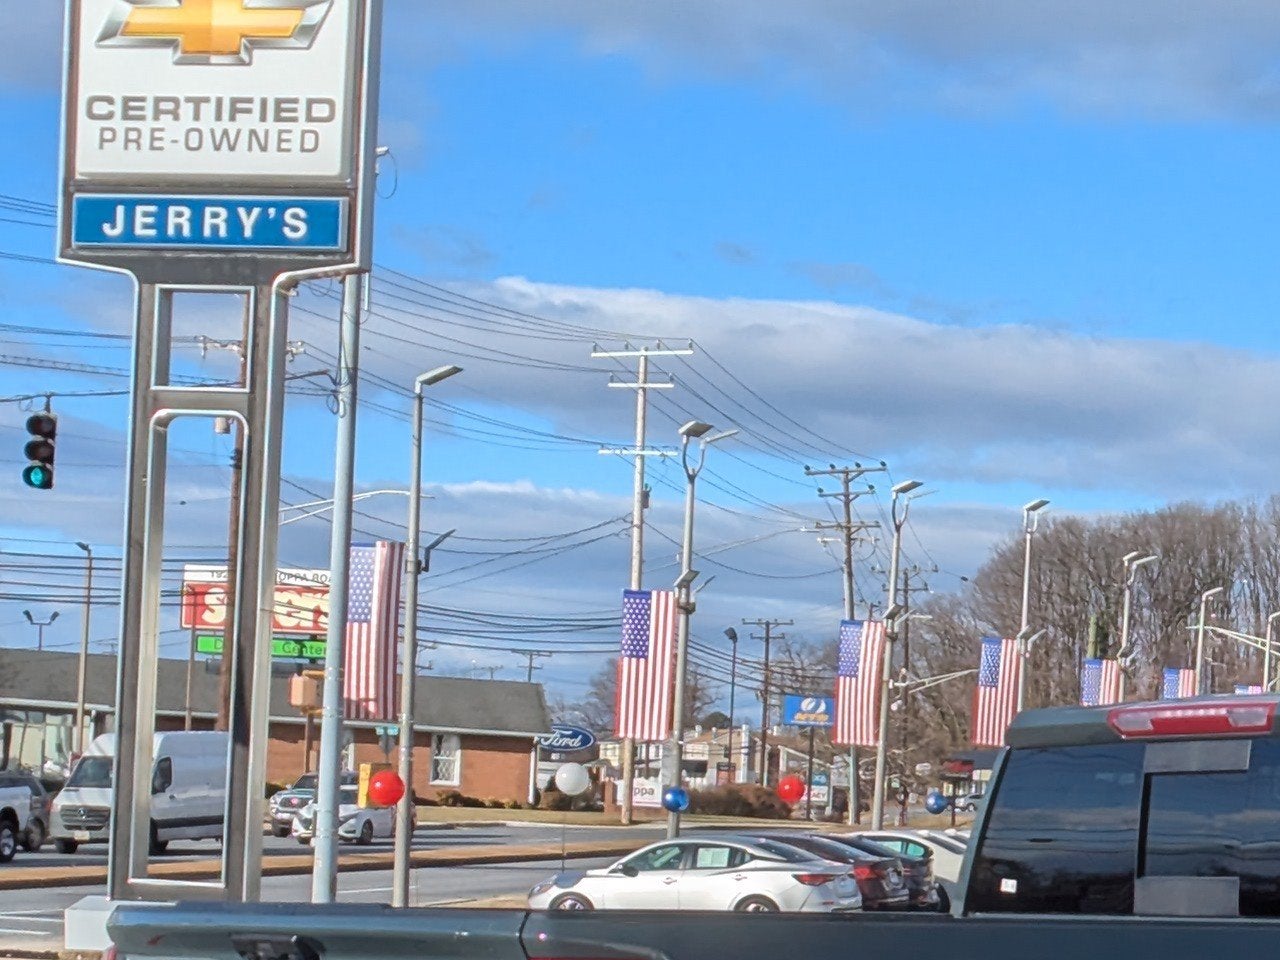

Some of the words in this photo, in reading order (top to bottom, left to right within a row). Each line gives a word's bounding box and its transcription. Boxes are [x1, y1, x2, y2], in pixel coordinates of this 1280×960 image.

[86, 95, 336, 123] CERTIFIED
[98, 126, 320, 153] PRE-OWNED
[102, 204, 309, 239] JERRY'S
[540, 729, 583, 748] Ford
[634, 786, 655, 796] ppa
